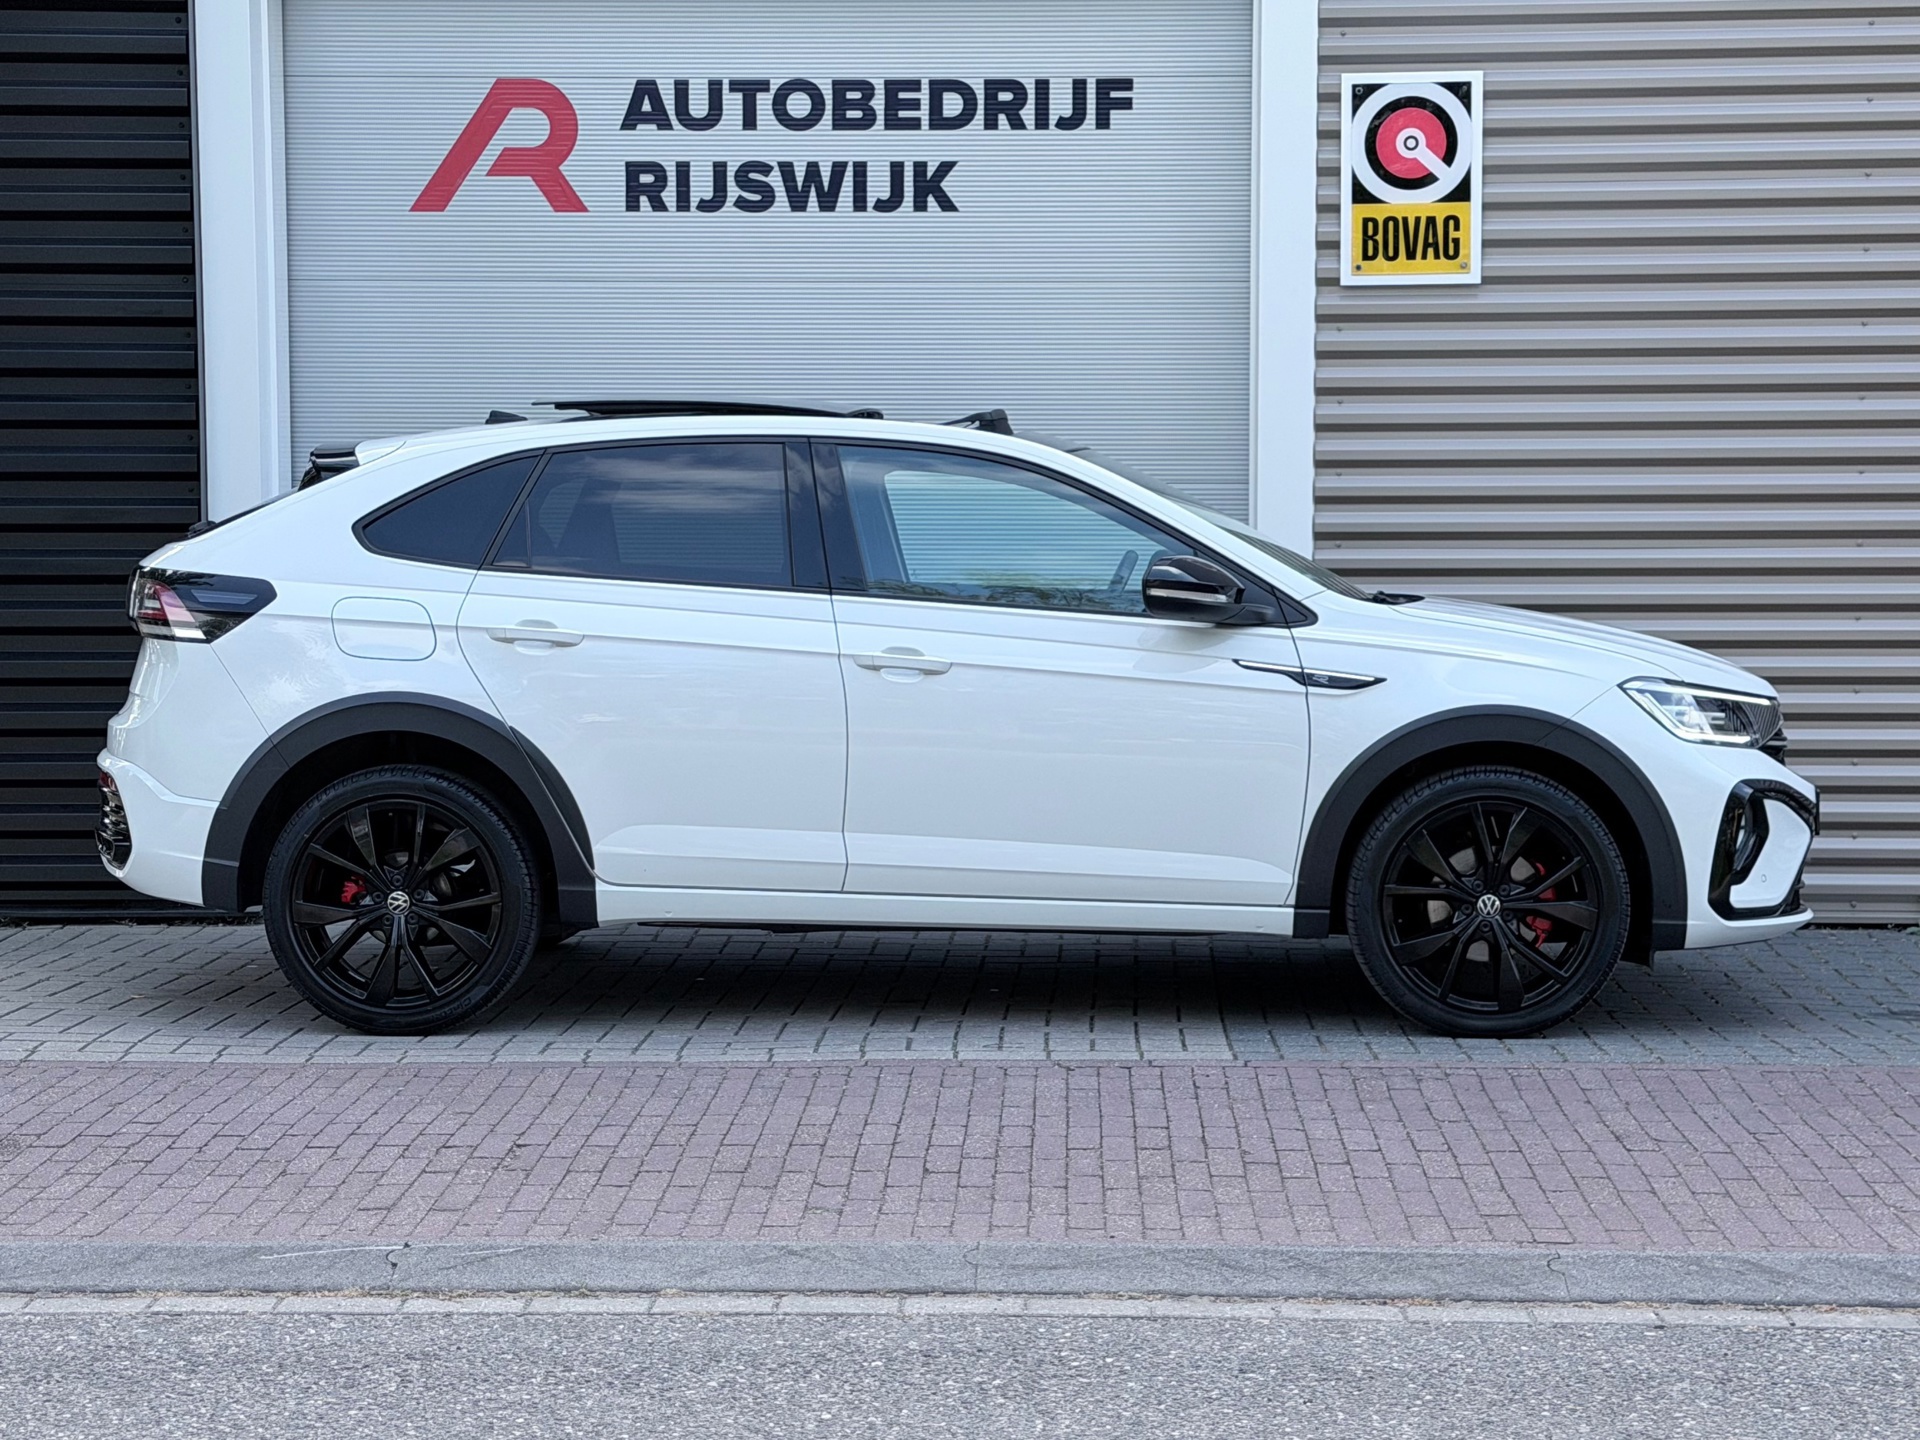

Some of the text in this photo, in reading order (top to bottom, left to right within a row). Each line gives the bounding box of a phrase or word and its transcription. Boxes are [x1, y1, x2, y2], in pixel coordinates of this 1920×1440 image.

[619, 78, 1135, 131] AUTOBEDRIJF
[624, 160, 960, 213] RIJSWIJK
[1361, 214, 1461, 262] BOVAG
